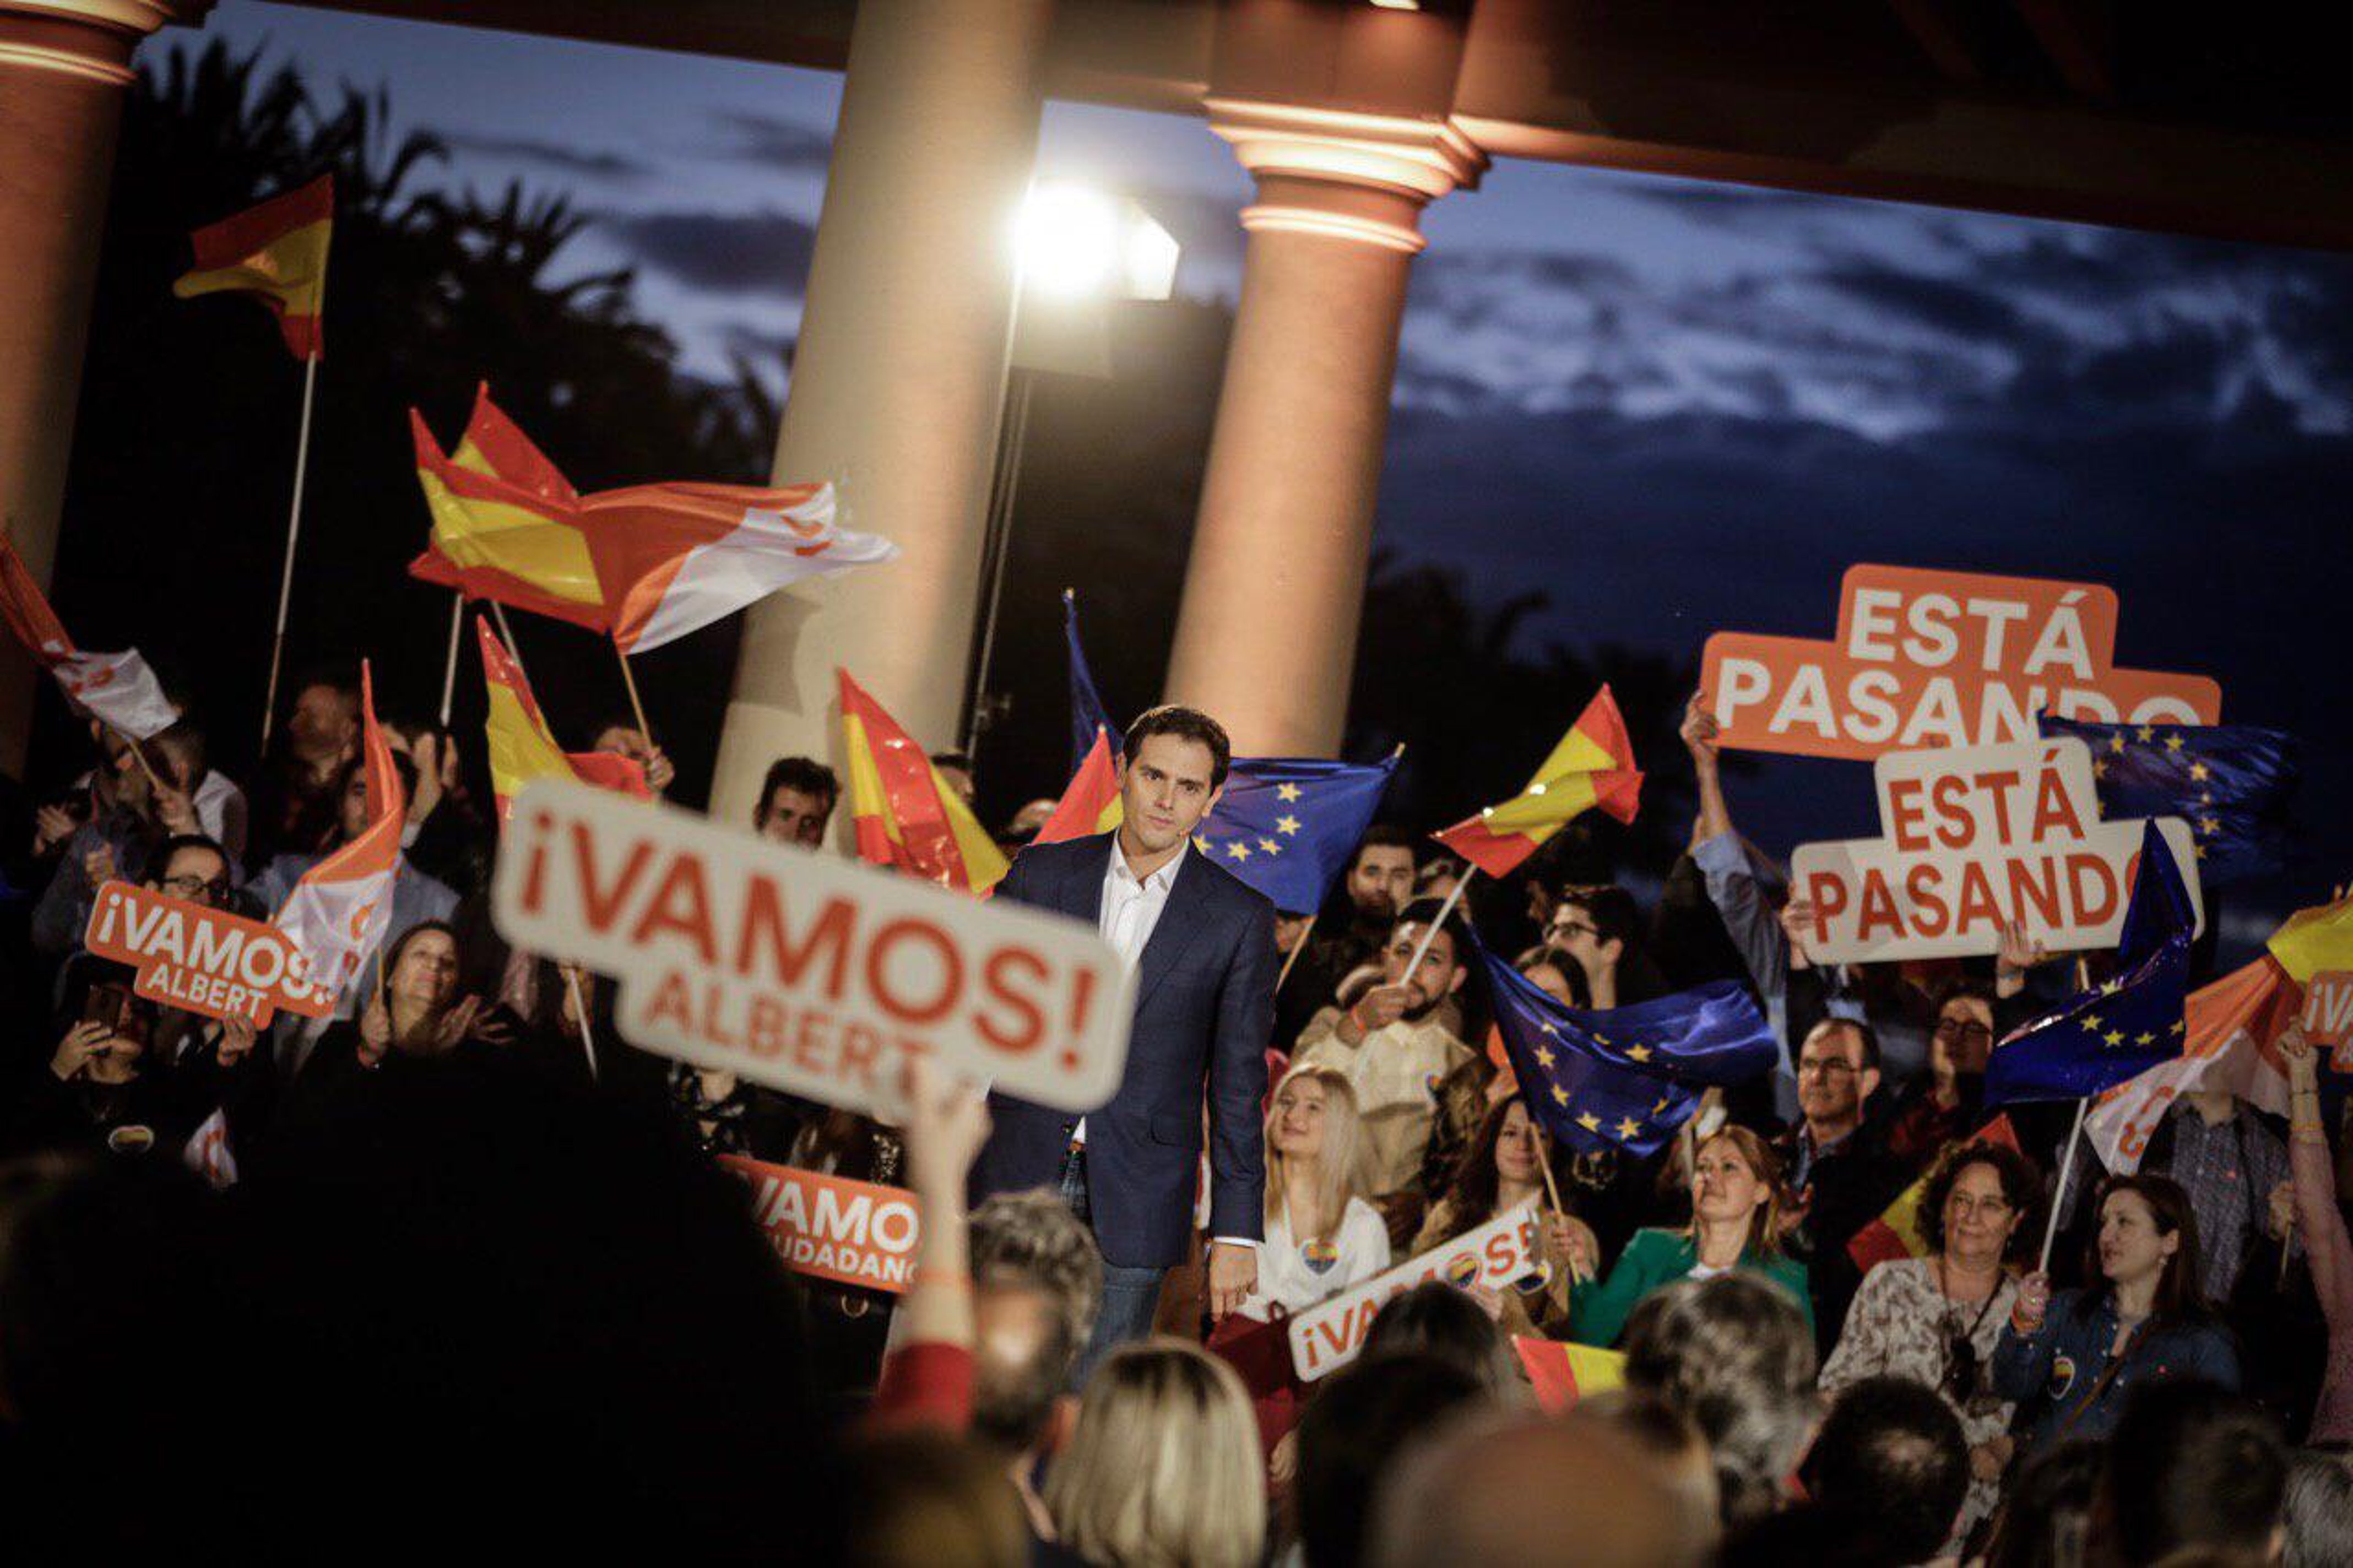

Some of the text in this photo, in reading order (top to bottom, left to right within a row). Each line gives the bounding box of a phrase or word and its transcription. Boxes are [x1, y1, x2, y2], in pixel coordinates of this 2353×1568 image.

[1848, 588, 2092, 680] ESTÁ
[1888, 748, 2085, 853] ESTÁ
[520, 810, 1096, 1071] ¡VAMOS!
[1808, 851, 2141, 943] PASAND
[147, 964, 269, 1018] ALBERT
[644, 972, 936, 1099] ALBERT
